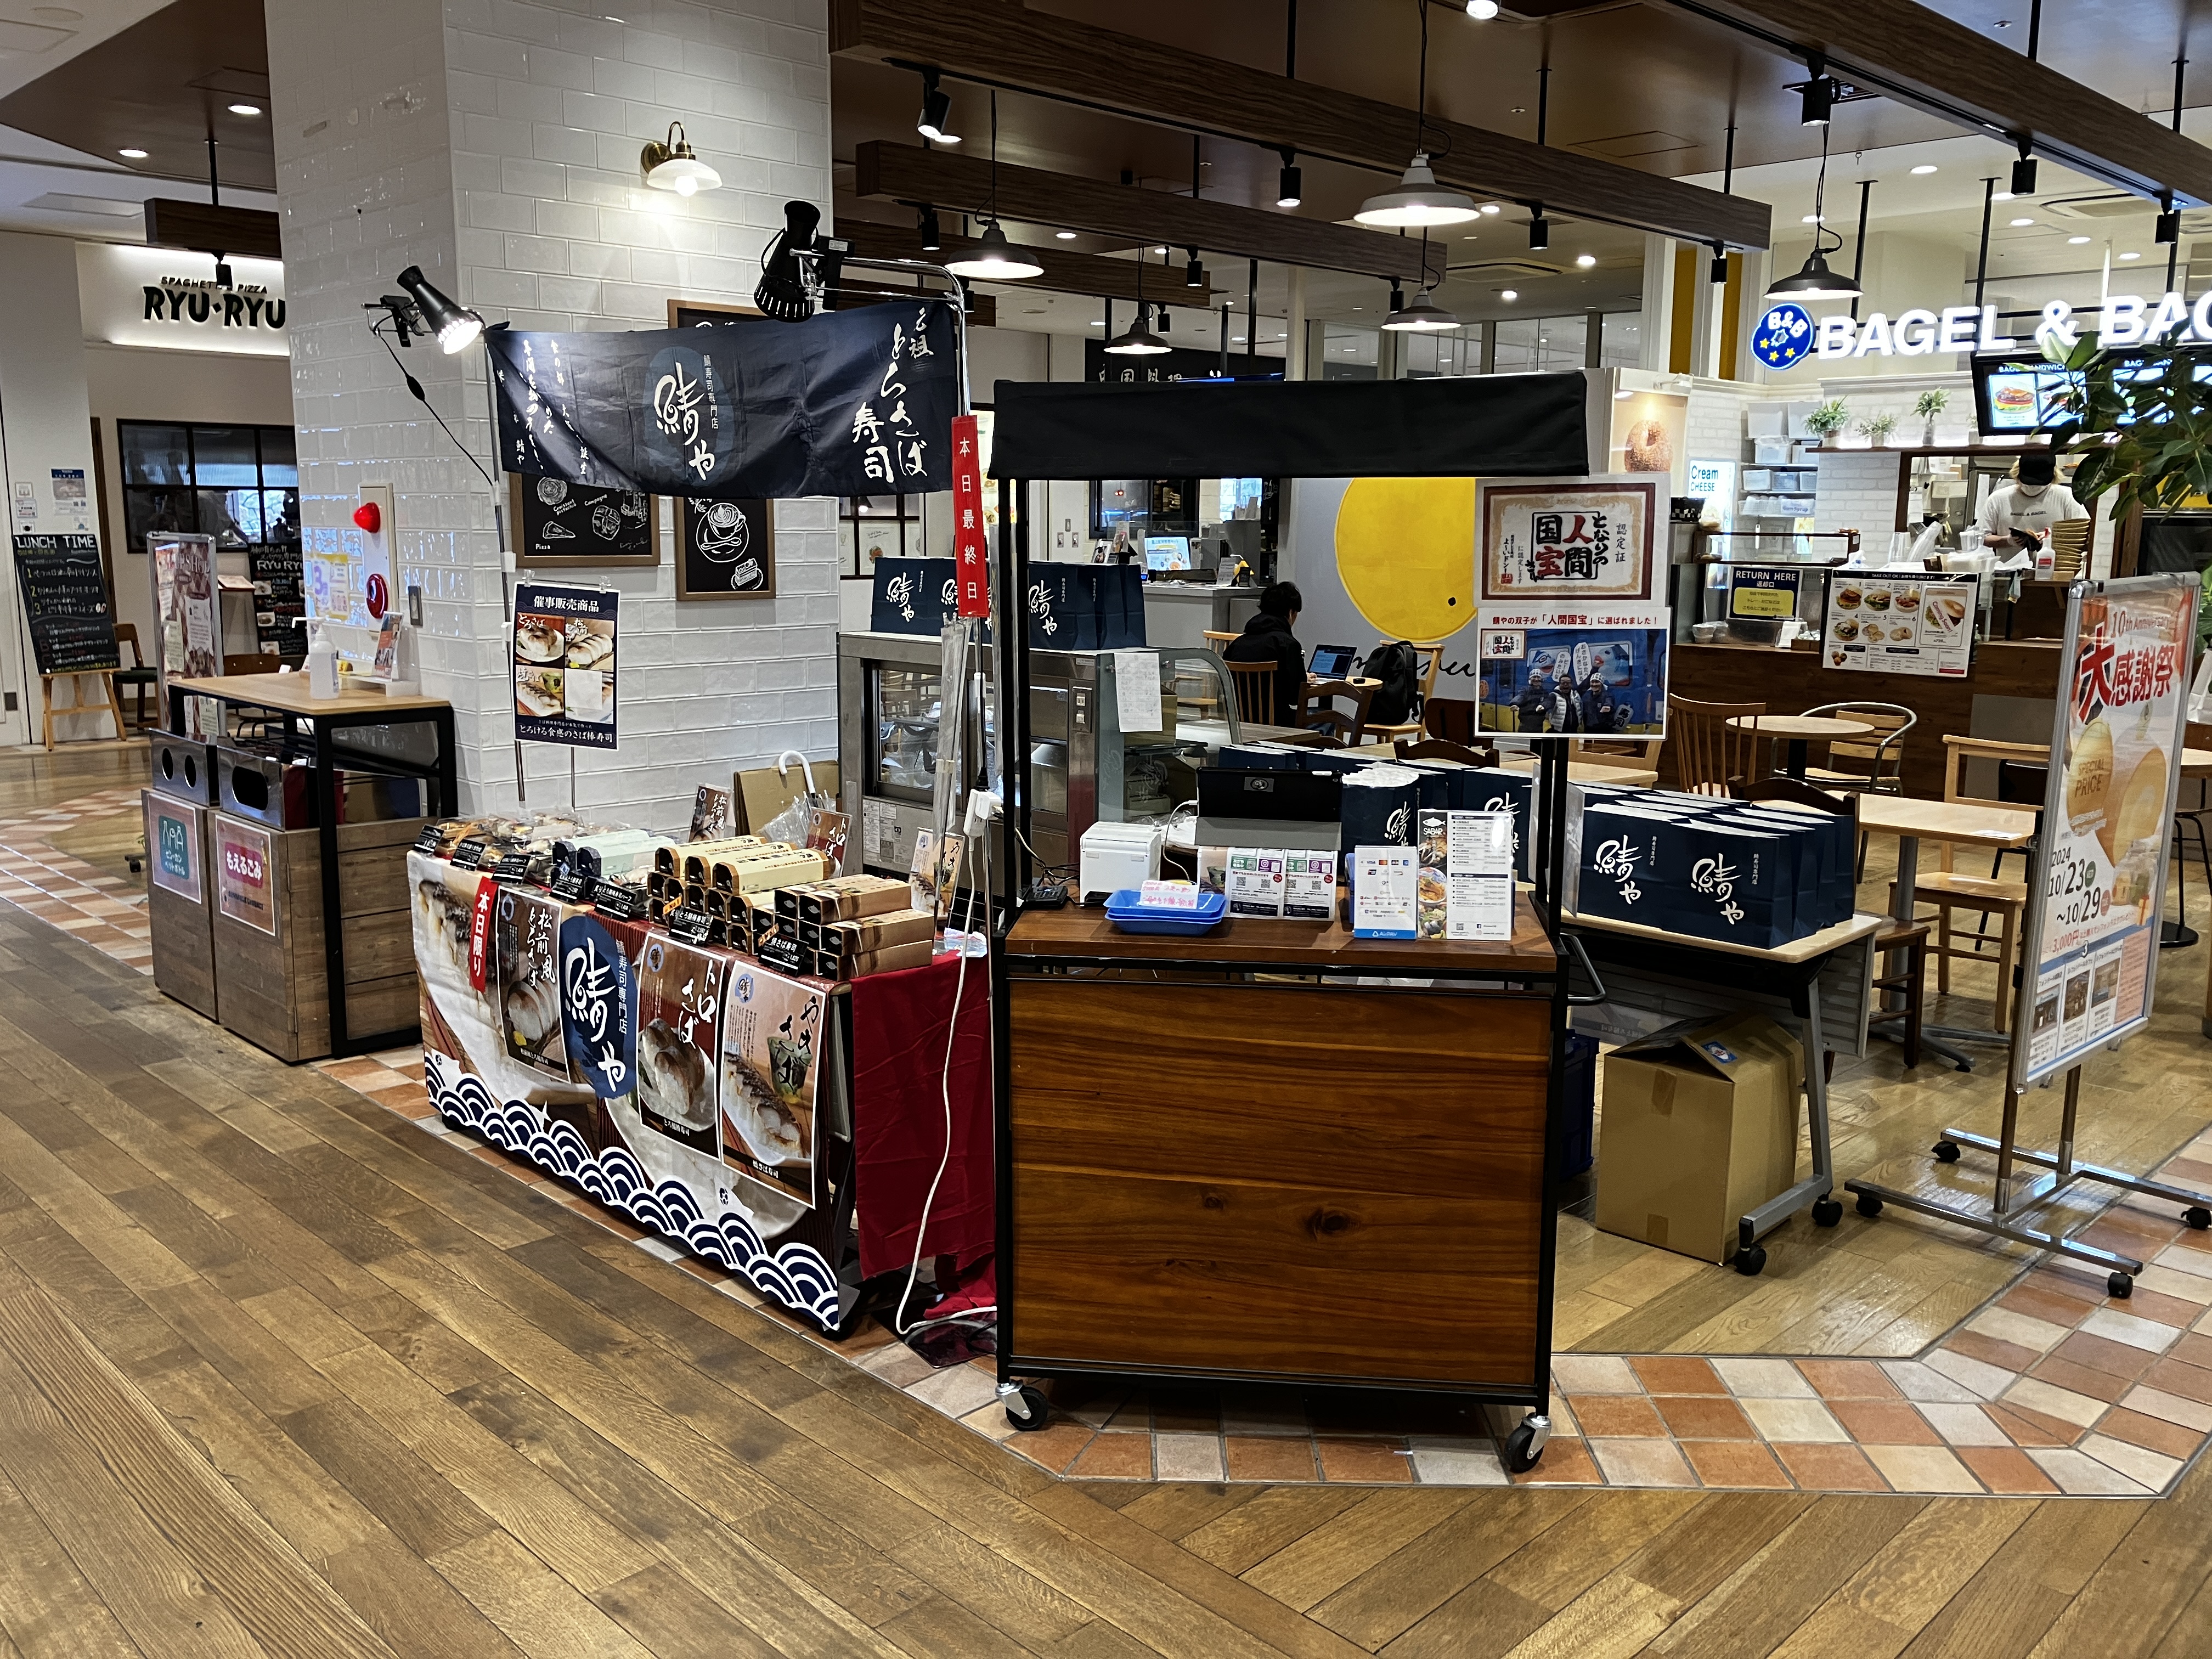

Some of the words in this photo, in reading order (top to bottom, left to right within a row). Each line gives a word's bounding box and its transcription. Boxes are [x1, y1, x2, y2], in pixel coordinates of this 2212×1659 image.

[238, 284, 267, 294] PIZZA
[1768, 311, 1808, 337] B&B
[1819, 304, 2016, 359] BAGEL
[2035, 300, 2080, 346] &
[703, 354, 718, 429] 鯖寿司専門店
[654, 362, 715, 481] 鯖や
[852, 402, 894, 483] 寿司
[1690, 482, 1716, 492] CHEESE
[1691, 465, 1718, 479] Cream
[15, 536, 57, 549] LUNCH
[63, 535, 96, 548] TIME
[959, 437, 977, 600] 本日最終日
[1592, 515, 1610, 565] となりの
[1615, 523, 1627, 563] 認定証
[1535, 514, 1565, 577] 国宝
[1562, 515, 1594, 579] 人間
[886, 572, 915, 622] 鯖や
[1736, 571, 1770, 579] RETURN
[1774, 572, 1797, 581] HERE
[534, 595, 600, 613] 催事販売商品
[1028, 579, 1058, 636] 鯖や
[1933, 601, 1944, 620] Coming
[2078, 622, 2176, 726] 大感謝祭
[2074, 774, 2104, 798] PRICE
[2078, 758, 2104, 776] SPECIAL
[1593, 834, 1643, 905] 鯖や
[2048, 859, 2085, 898] 10/23
[2051, 847, 2072, 867] 2024
[1690, 853, 1745, 925] 鯖や
[472, 891, 489, 977] 本日限り
[535, 908, 555, 984] 松前風
[770, 936, 797, 953] 焼さば寿司
[616, 939, 628, 1035] 鯖寿司専門店
[678, 978, 699, 1049] さば
[566, 937, 627, 1092] 鯖や
